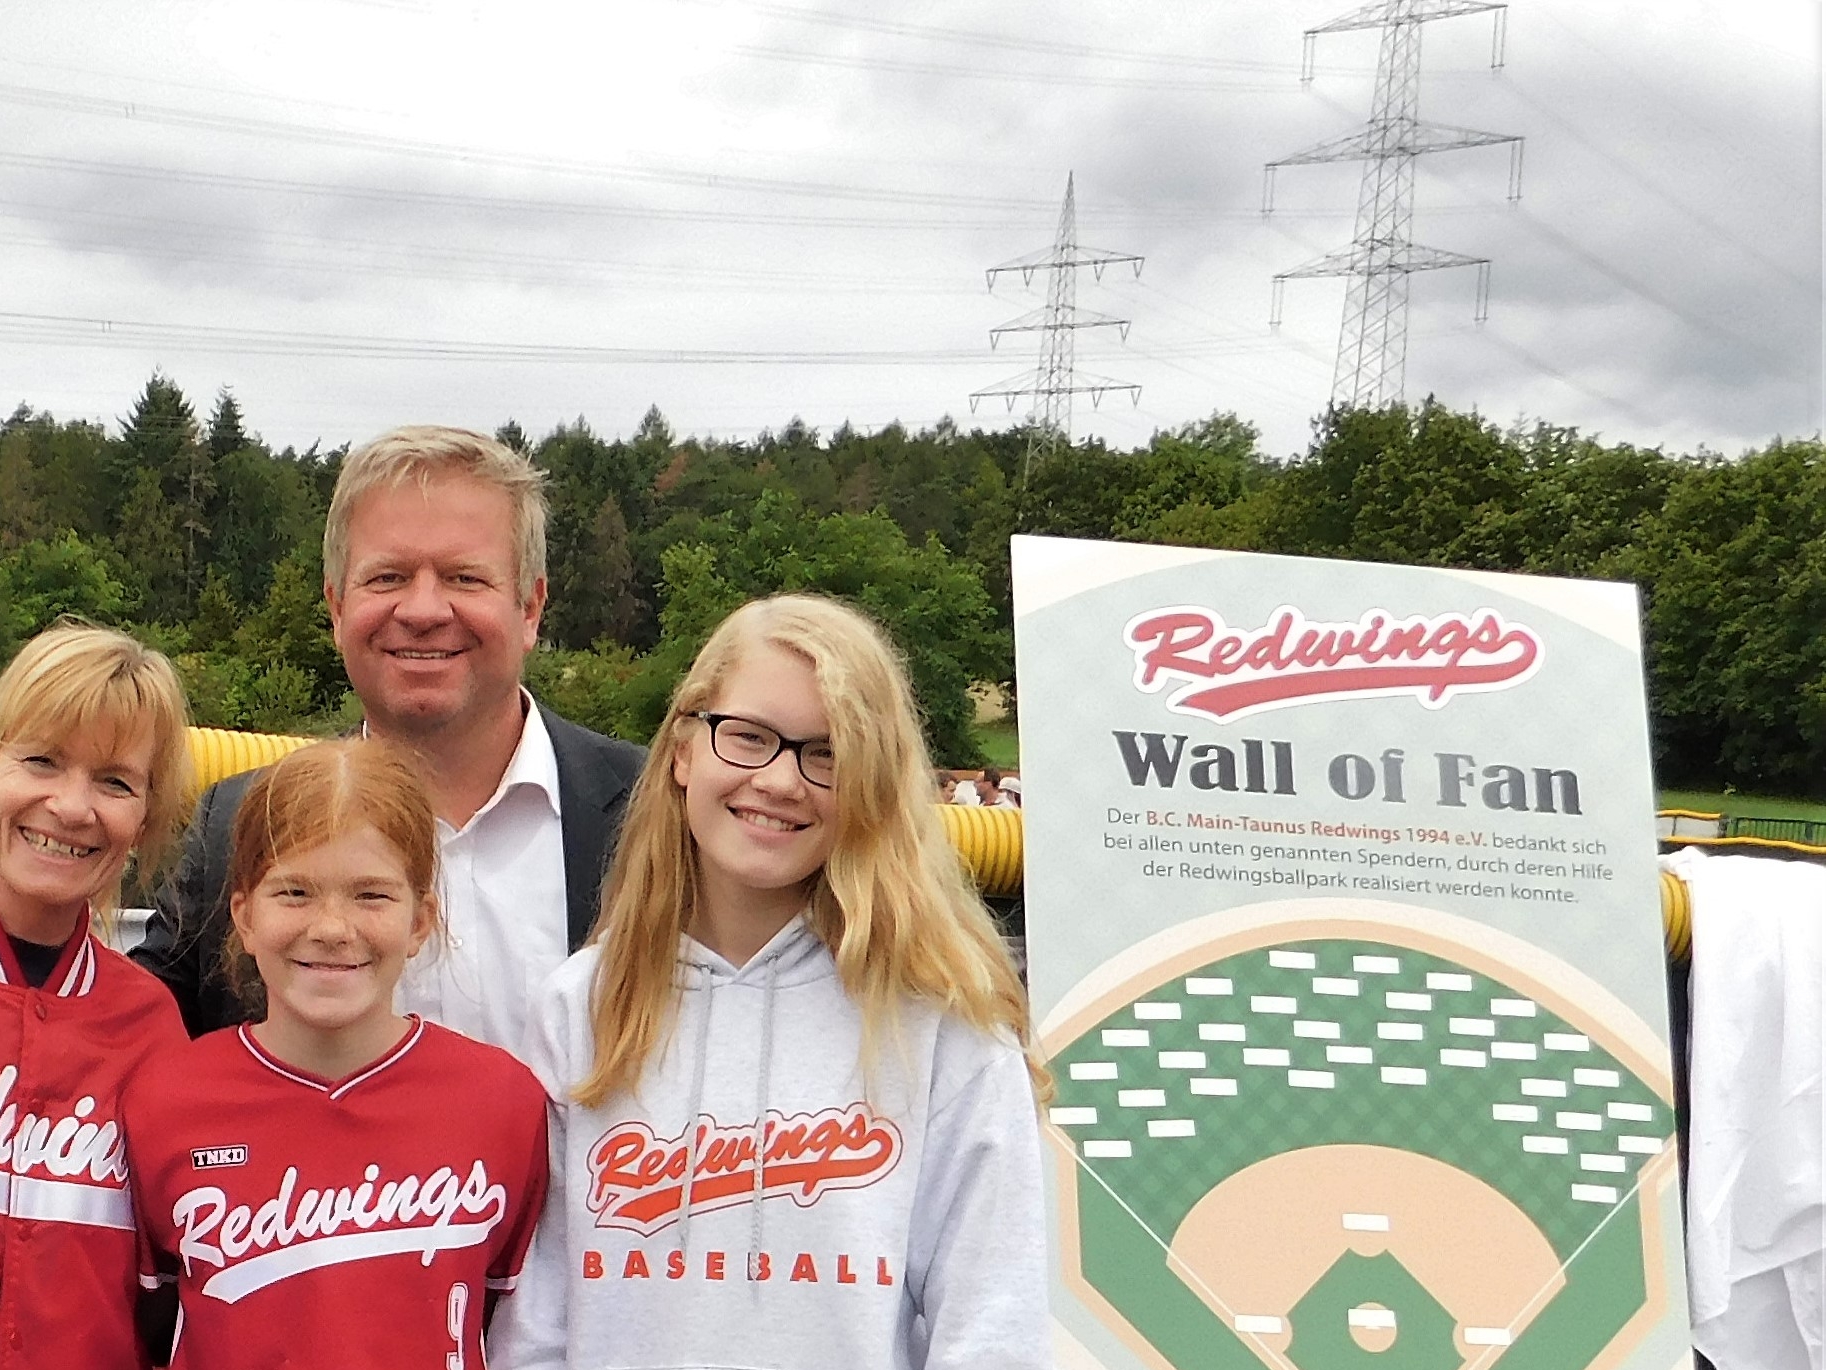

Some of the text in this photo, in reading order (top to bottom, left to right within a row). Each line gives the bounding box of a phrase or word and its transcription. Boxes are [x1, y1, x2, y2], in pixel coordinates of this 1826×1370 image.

[1130, 611, 1540, 703] Redwings
[1111, 730, 1583, 816] Wall of Fan
[1107, 808, 1607, 855] Der B.C. Main-Taunus Redwings 1994 e.V. bedankt sich
[1103, 833, 1614, 880] bei allen unten genannten Spendern, durch deren Hilfe
[1142, 861, 1580, 903] der Redwingsballpark realisiert werden konnte.
[194, 1148, 245, 1166] TNKD
[595, 1114, 893, 1202] Redwings
[173, 1160, 506, 1280] Redwings
[583, 1250, 893, 1286] BASEBALL
